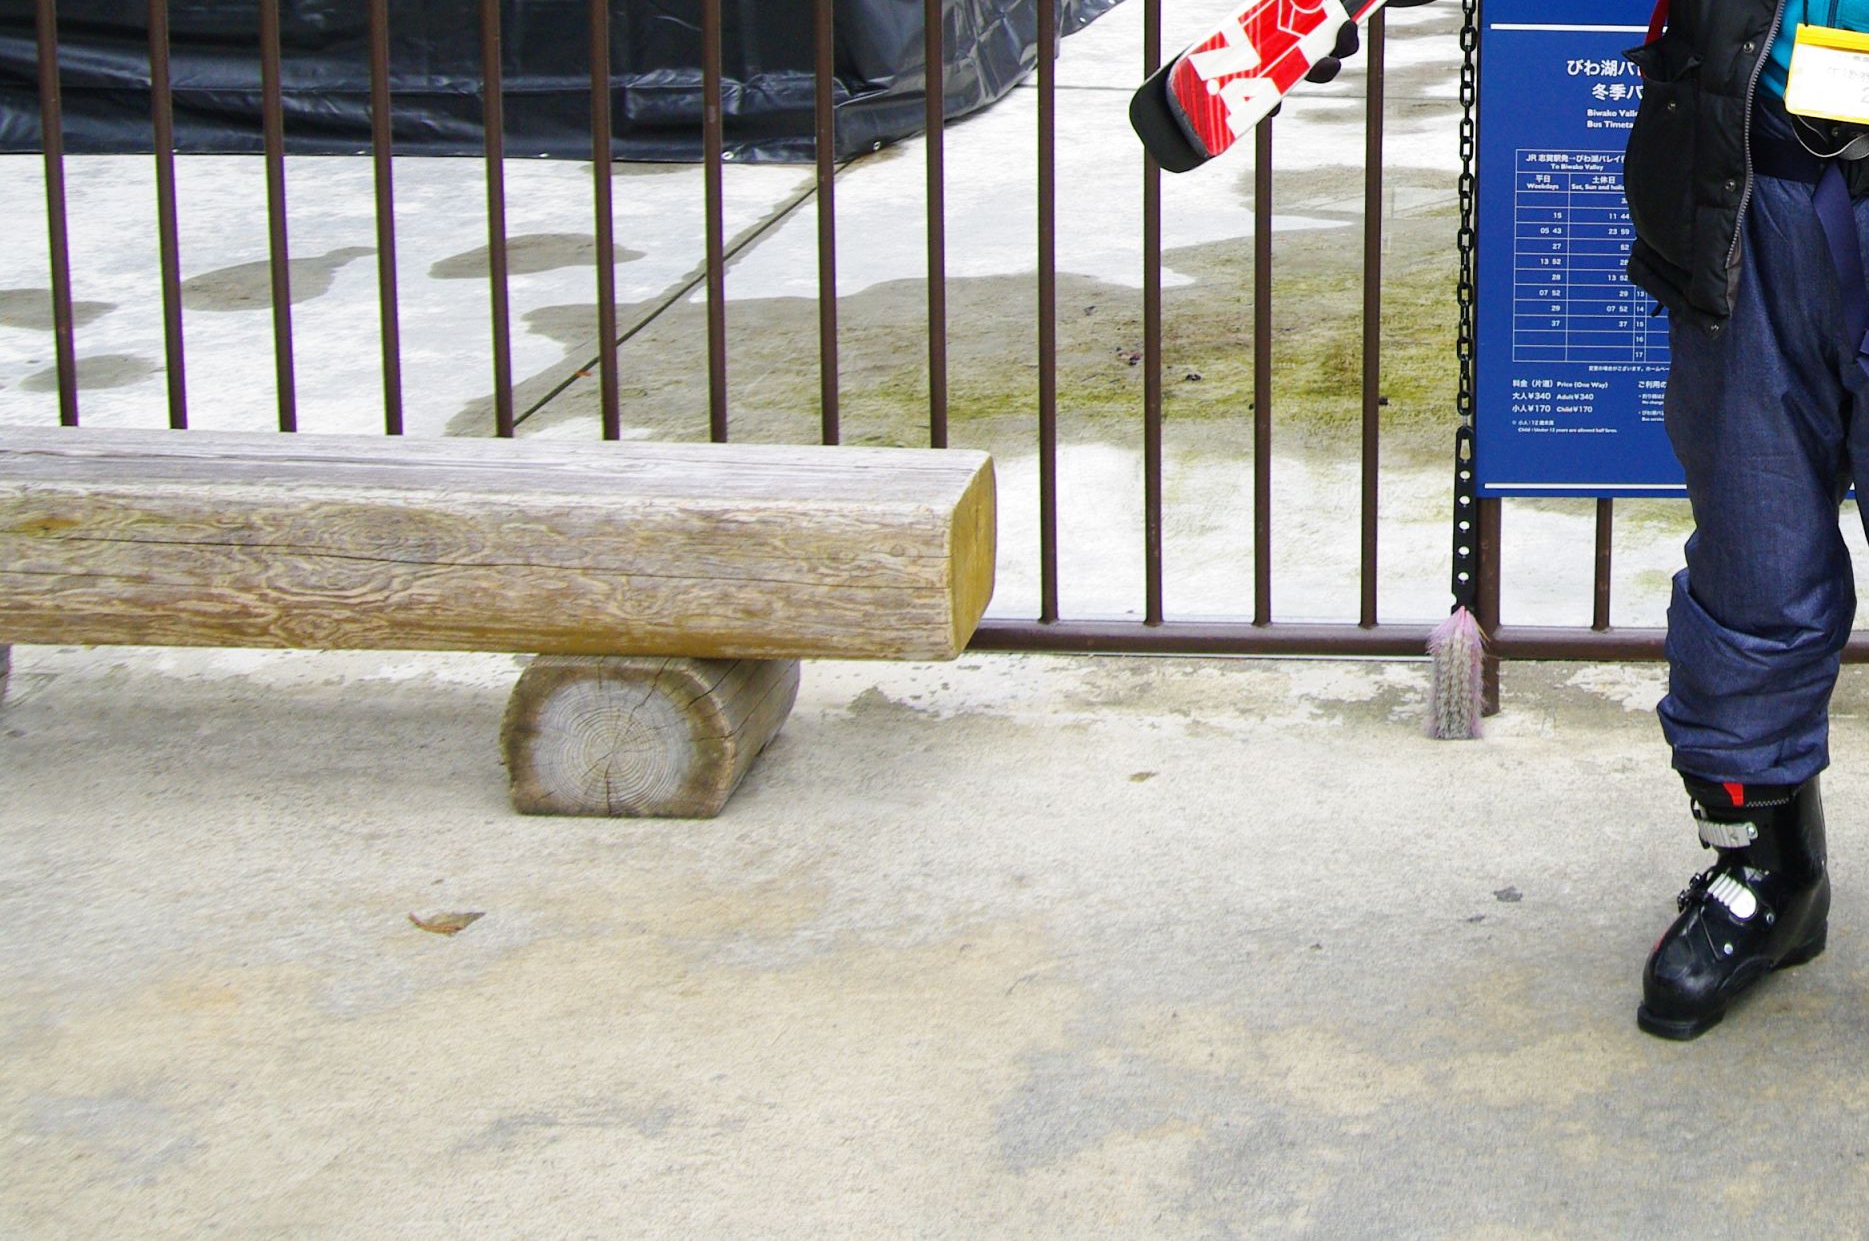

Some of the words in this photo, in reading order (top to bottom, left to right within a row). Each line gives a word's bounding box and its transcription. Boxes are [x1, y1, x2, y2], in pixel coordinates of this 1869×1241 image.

[1586, 108, 1618, 118] Biwako
[1586, 120, 1603, 129] Bus
[1584, 163, 1604, 173] Valley
[1535, 174, 1551, 184] 平日
[1606, 305, 1616, 313] 07
[1636, 305, 1645, 313] 14
[1551, 319, 1561, 327] 37
[1618, 320, 1628, 328] 37
[1556, 381, 1573, 389] Price
[1573, 381, 1590, 389] (One
[1590, 381, 1609, 390] Way)
[1512, 392, 1551, 401] 大人¥340
[1512, 404, 1551, 413] 小人¥170
